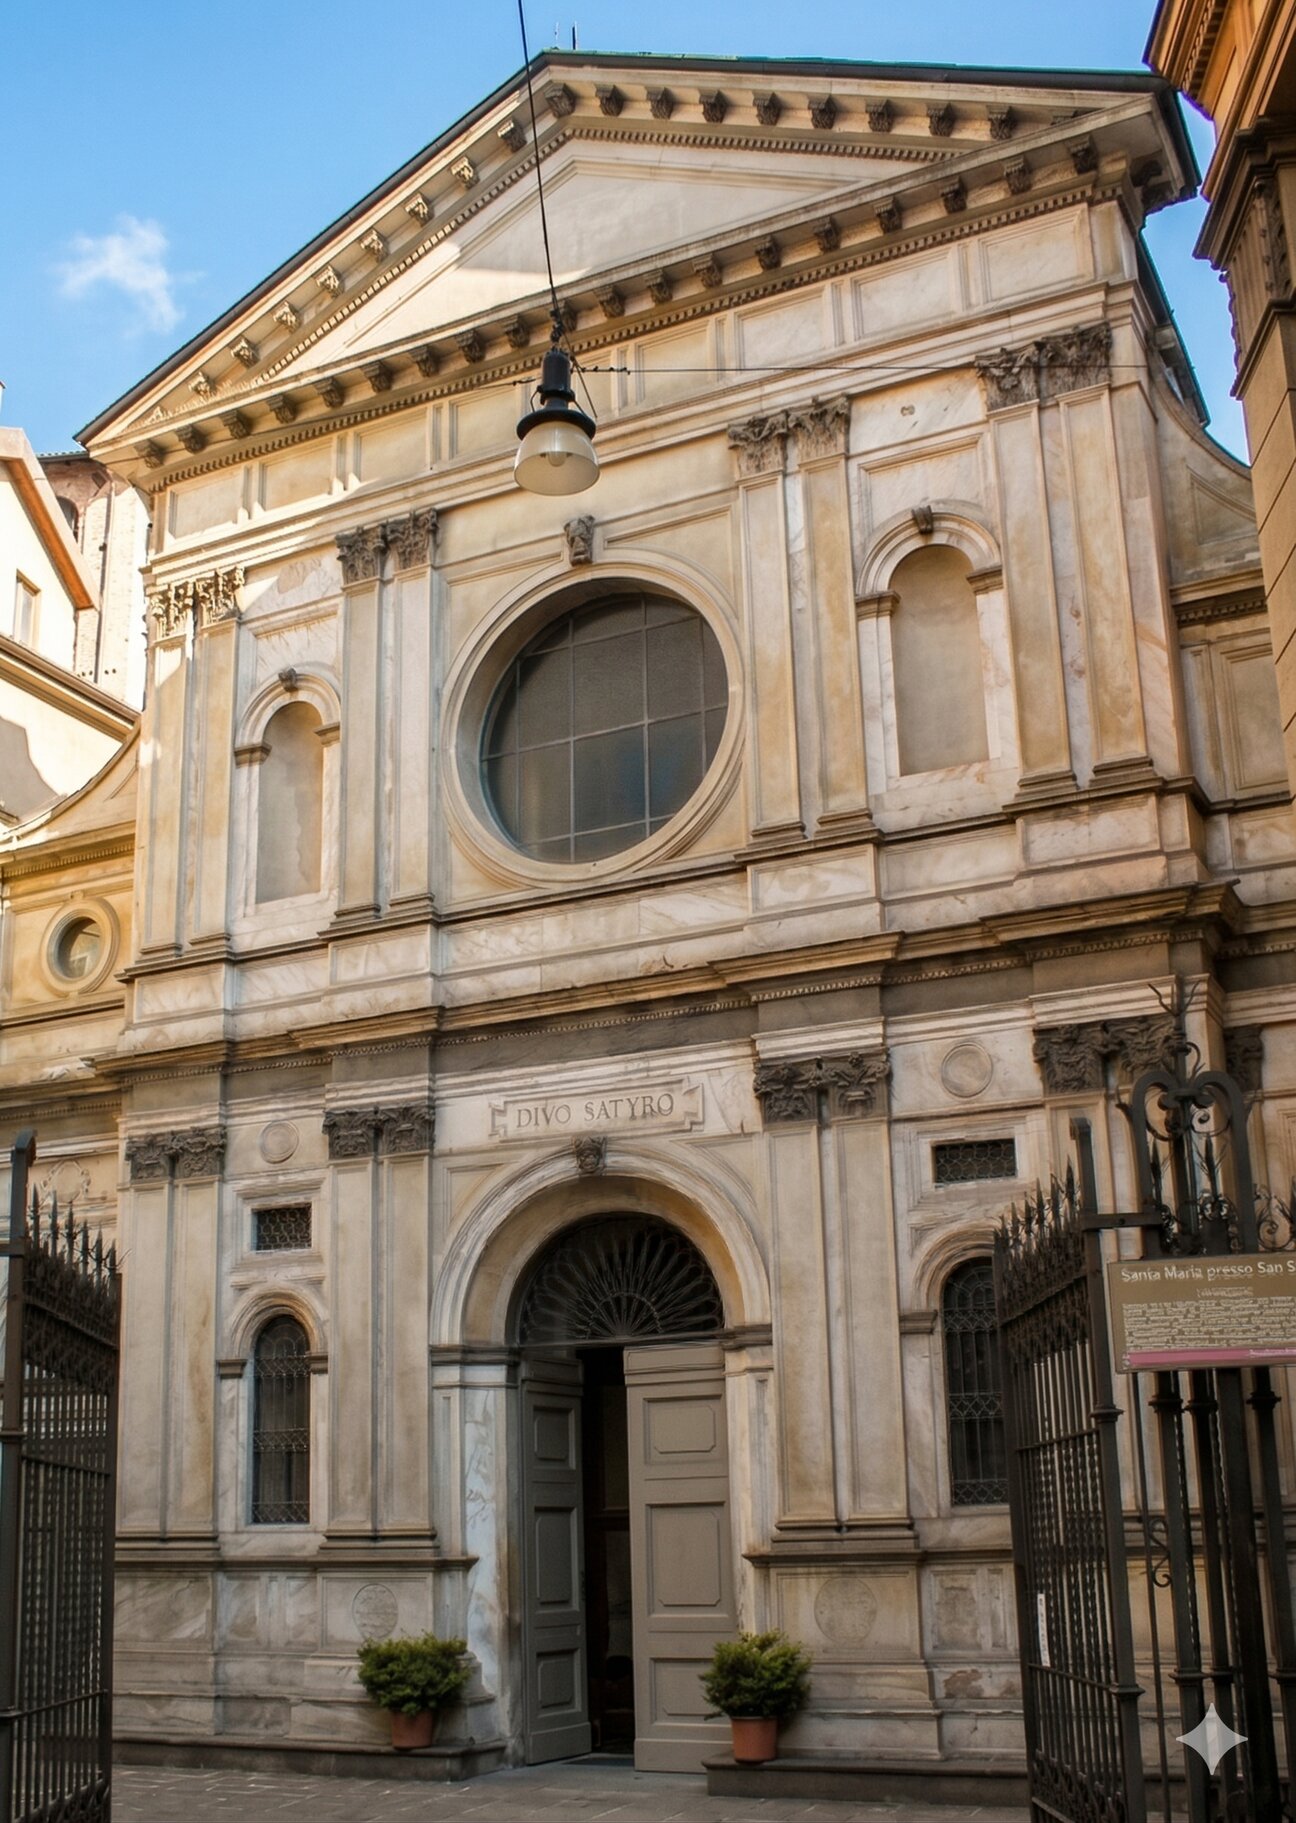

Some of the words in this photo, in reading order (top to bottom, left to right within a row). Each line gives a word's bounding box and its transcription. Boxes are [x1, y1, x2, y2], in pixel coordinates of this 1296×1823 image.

[516, 1104, 571, 1128] DIVO
[584, 1093, 674, 1121] SATYRO
[1164, 1265, 1203, 1280] Maria
[1207, 1265, 1253, 1281] presso
[1257, 1261, 1283, 1274] San
